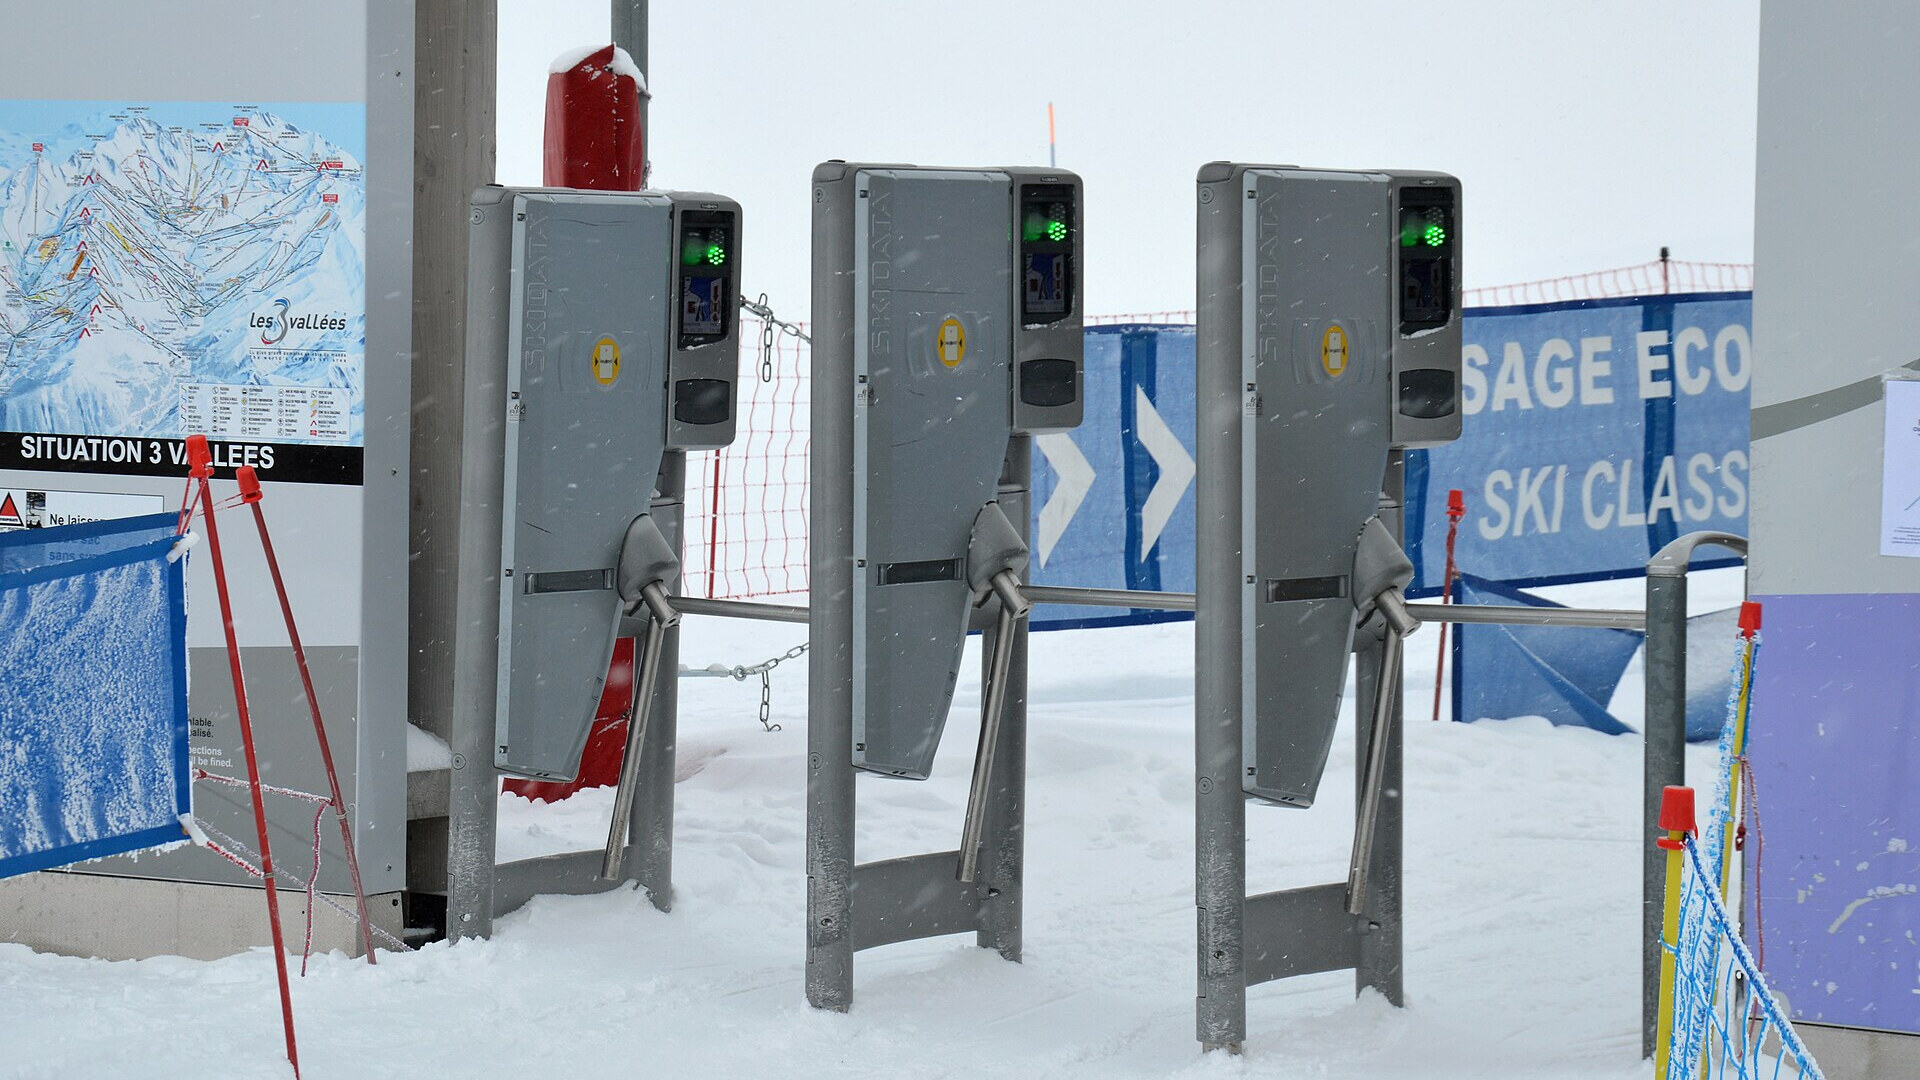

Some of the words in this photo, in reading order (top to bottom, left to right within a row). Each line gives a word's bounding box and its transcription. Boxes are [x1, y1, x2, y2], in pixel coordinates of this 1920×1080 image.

[525, 214, 548, 372] SKIDATA
[871, 192, 891, 354] SKIDATA
[1259, 192, 1279, 361] SKIDATA
[290, 314, 347, 330] vallées
[1462, 336, 1615, 416] SAGE
[1636, 324, 1751, 400] ECO
[20, 436, 142, 463] SITUATION
[149, 441, 162, 464] 3
[168, 441, 275, 469] VLEES
[1478, 464, 1568, 541] SKI
[1582, 450, 1749, 530] CLASS
[50, 514, 64, 526] Ne
[198, 756, 208, 766] be
[210, 757, 233, 767] fined.
